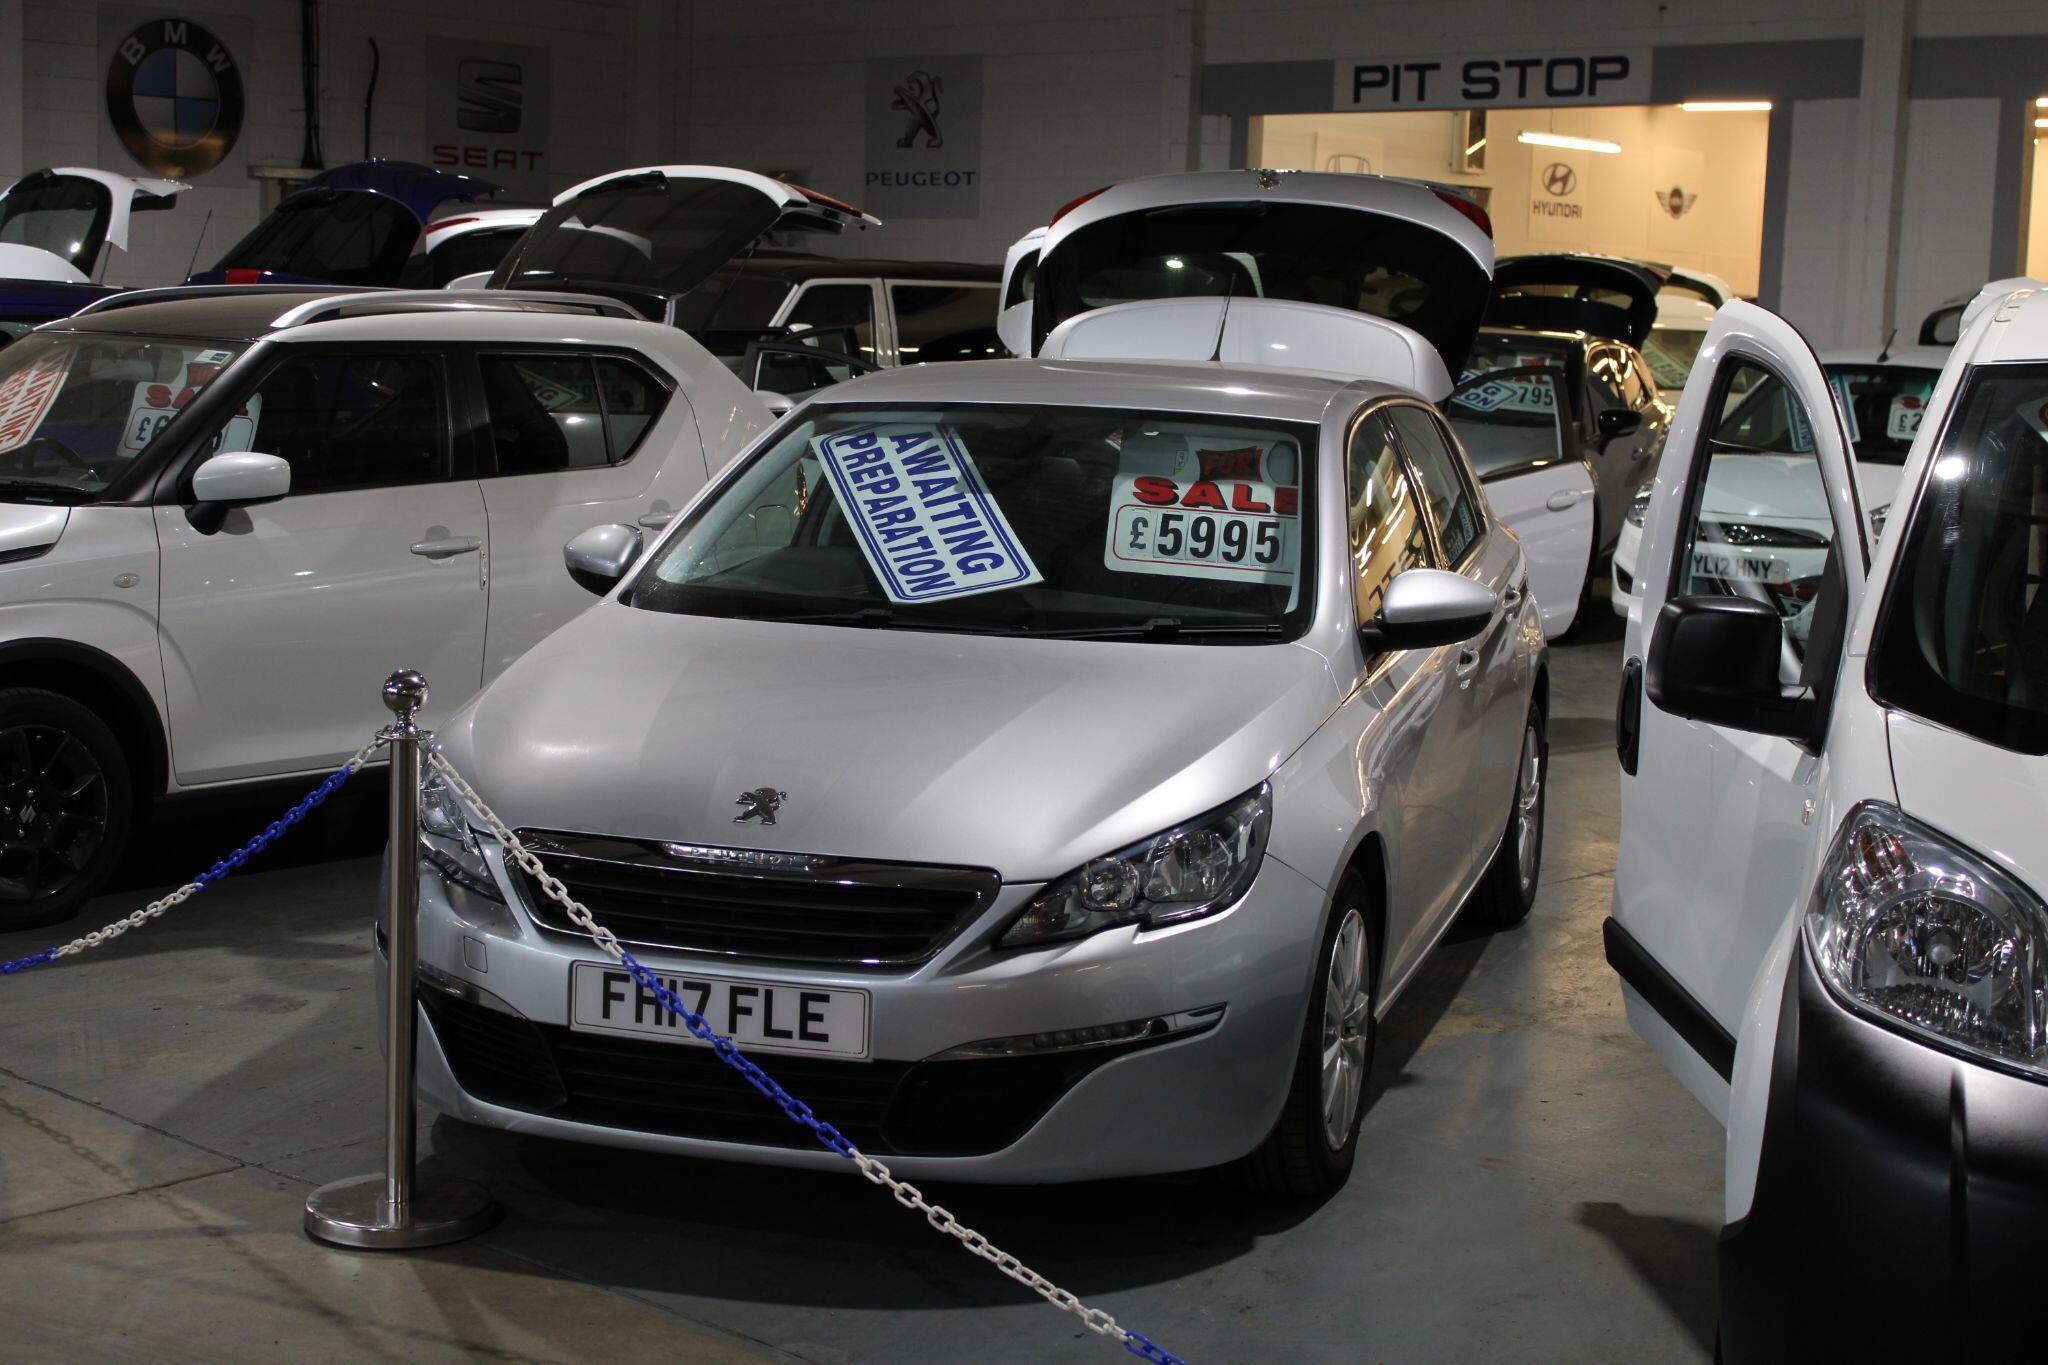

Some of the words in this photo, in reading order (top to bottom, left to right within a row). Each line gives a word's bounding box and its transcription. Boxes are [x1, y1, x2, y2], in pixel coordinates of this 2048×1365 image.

[120, 20, 232, 73] BMW
[1353, 63, 1441, 103] PIT
[1461, 56, 1630, 100] STOP
[433, 145, 544, 170] SEAT
[865, 170, 977, 187] PEUGEOT
[1532, 199, 1584, 220] HYUNDAI
[835, 431, 956, 593] PREPARATION
[889, 431, 1005, 575] AWAITING
[1133, 475, 1298, 516] SALE
[1129, 513, 1281, 564] £5995
[728, 985, 831, 1043] FLE
